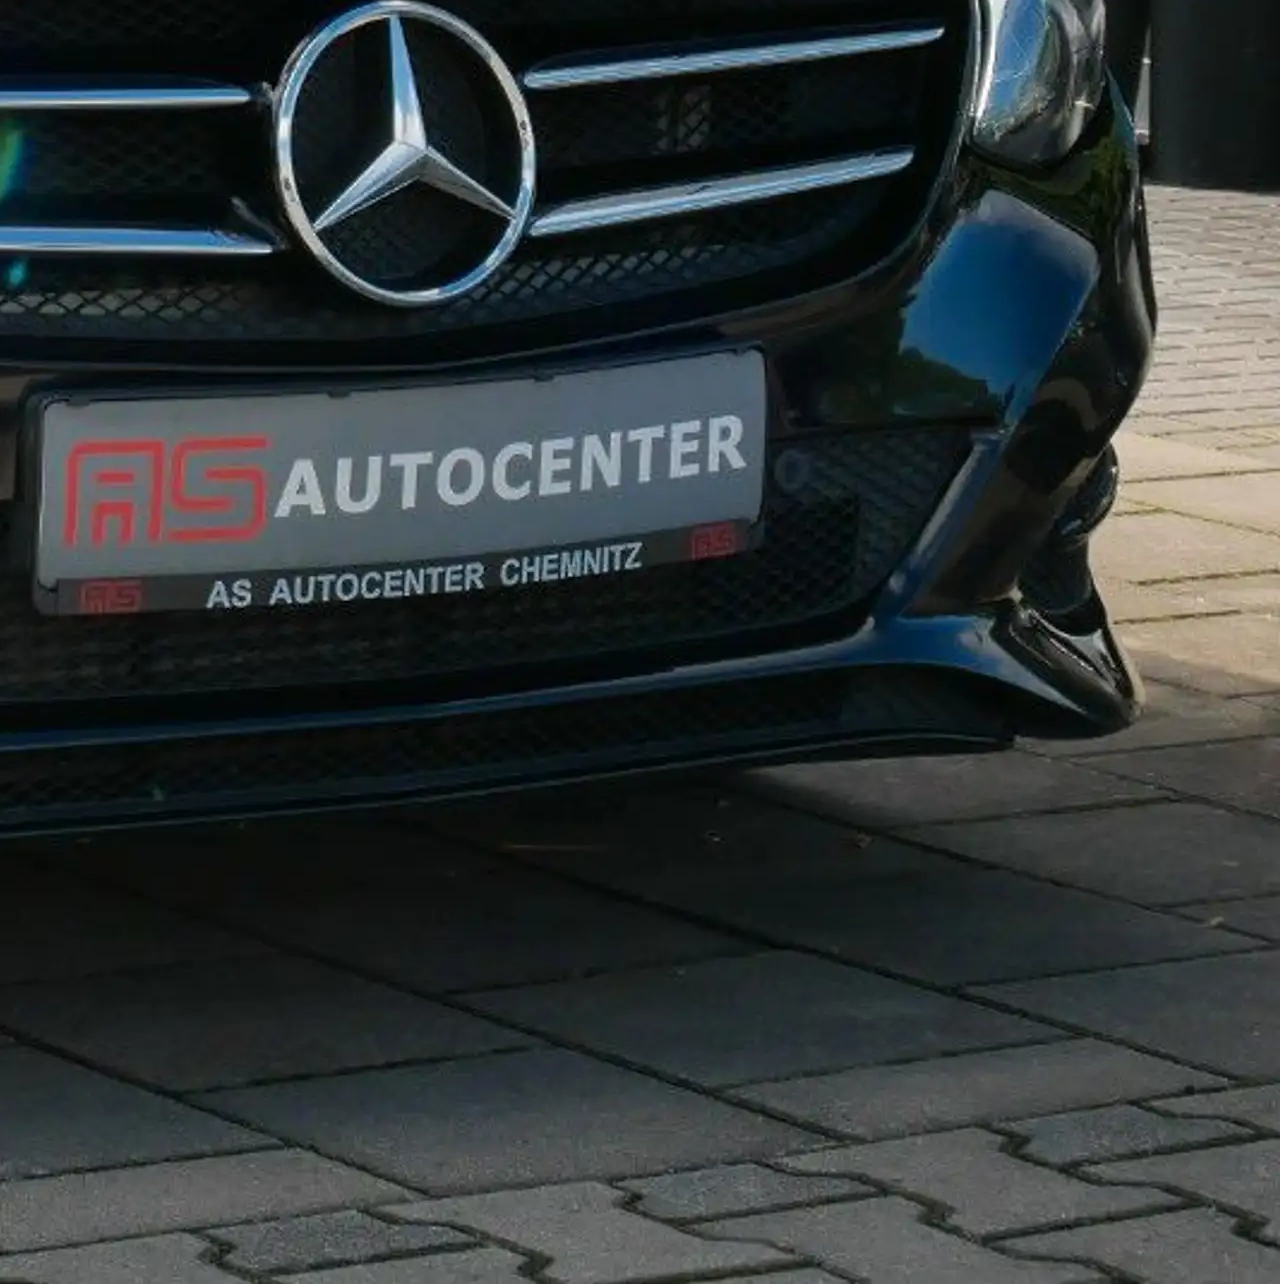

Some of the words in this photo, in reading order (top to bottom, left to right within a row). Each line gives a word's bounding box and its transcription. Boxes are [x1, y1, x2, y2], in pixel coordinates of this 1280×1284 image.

[62, 437, 268, 550] AS
[274, 415, 747, 519] AUTOCENTER
[206, 578, 253, 609] AS
[269, 563, 485, 607] AUTOCENTER
[500, 542, 643, 588] CHEMNITZ
